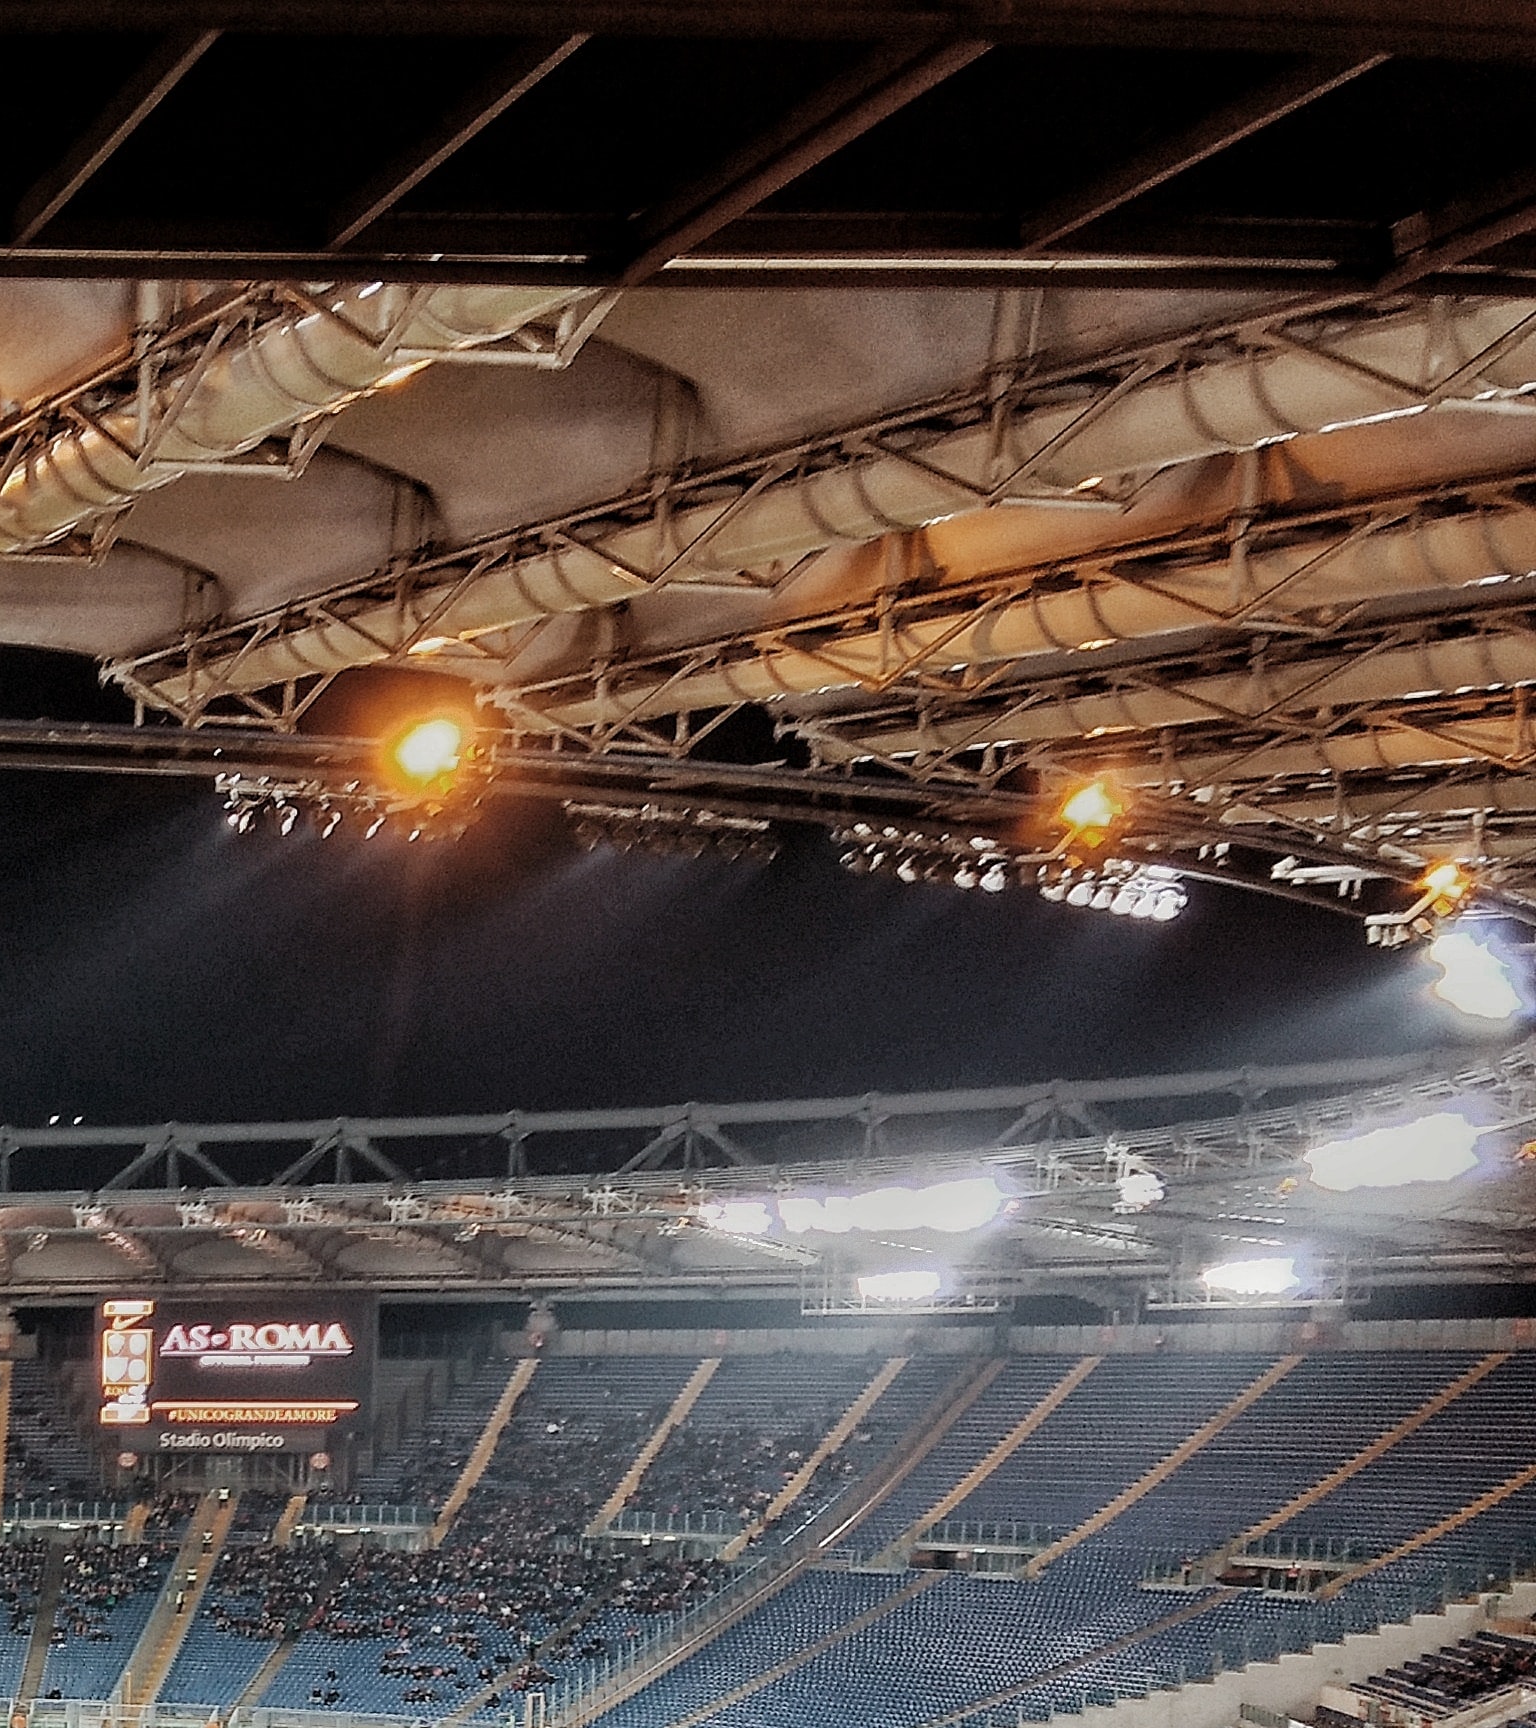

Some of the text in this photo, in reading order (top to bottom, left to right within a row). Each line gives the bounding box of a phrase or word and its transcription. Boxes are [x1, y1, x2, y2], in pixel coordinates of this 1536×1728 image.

[229, 1323, 354, 1350] ROMA
[168, 1408, 339, 1422] #UNICOGRANDEAMORE
[159, 1431, 285, 1450] Stadio Olimpico
